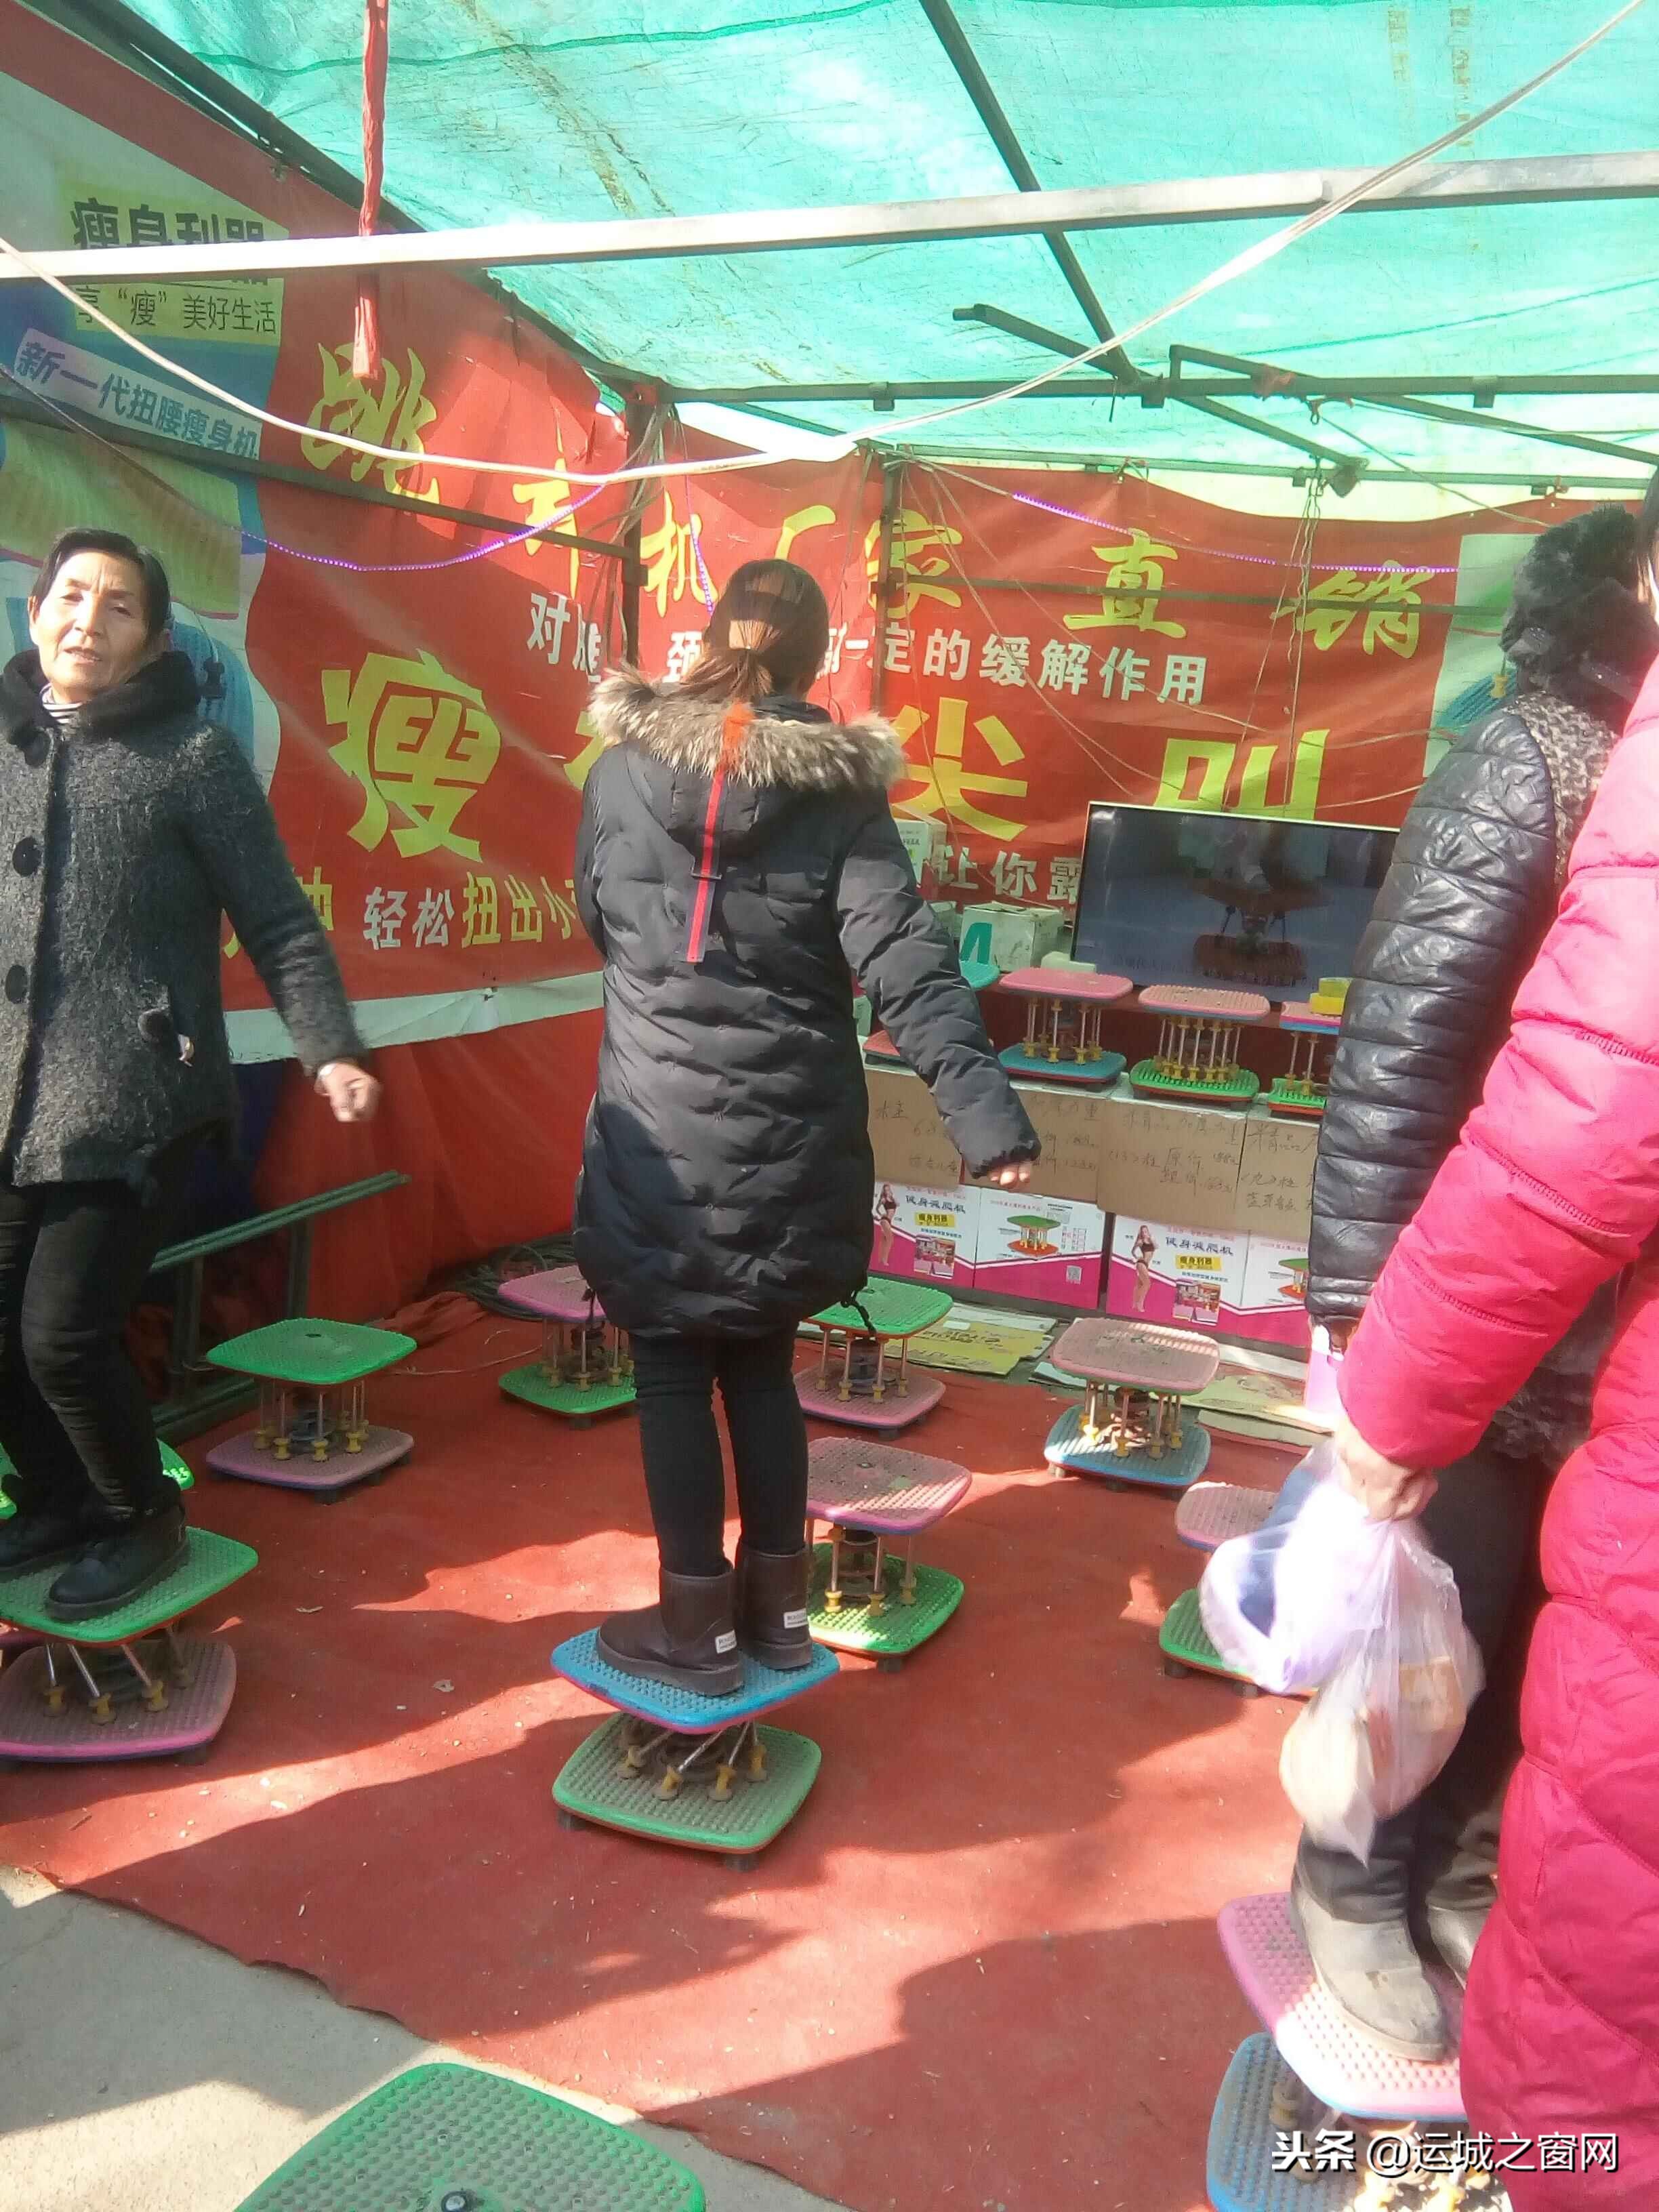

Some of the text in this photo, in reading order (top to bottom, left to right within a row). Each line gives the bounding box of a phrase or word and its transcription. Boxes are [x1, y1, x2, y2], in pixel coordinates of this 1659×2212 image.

[18, 342, 258, 459] 新一代扭腰瘦身机
[363, 871, 576, 951] 轻松扭出小
